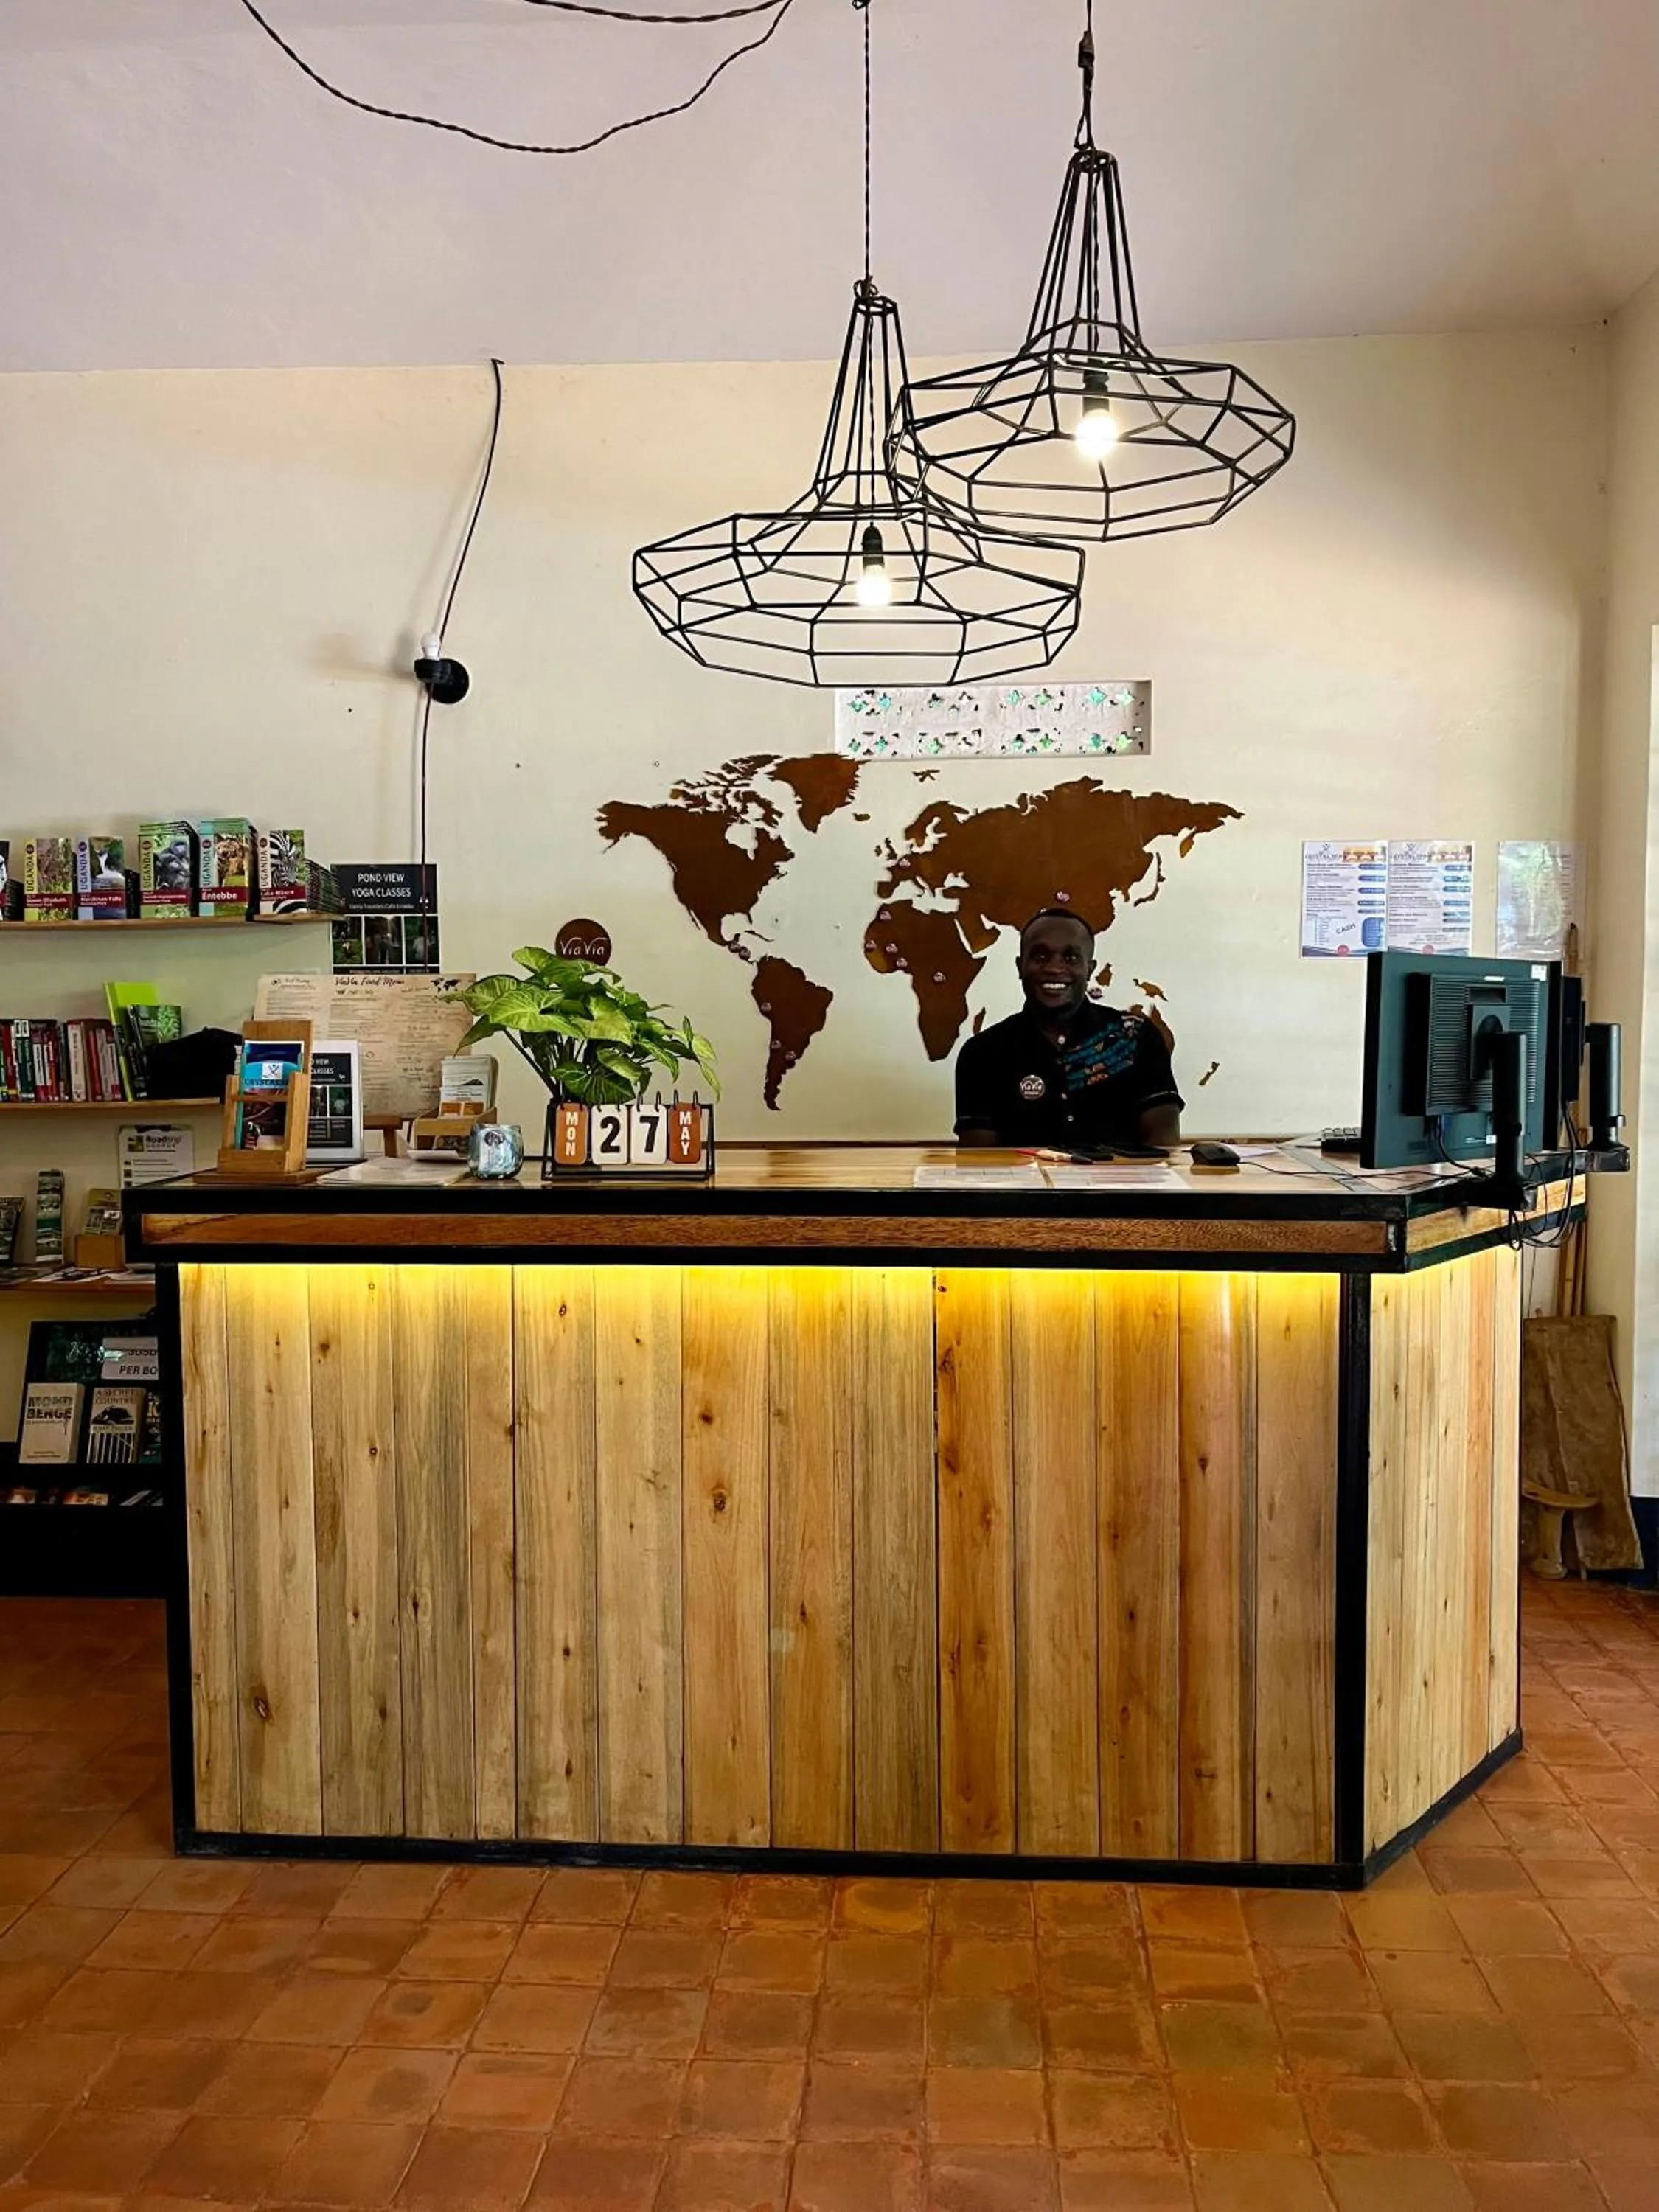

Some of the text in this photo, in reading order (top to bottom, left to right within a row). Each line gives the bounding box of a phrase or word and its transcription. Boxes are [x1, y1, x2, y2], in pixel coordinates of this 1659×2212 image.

[26, 856, 35, 892] UGANDA
[80, 853, 88, 891] UGANDA
[142, 852, 151, 890] UGANDA
[202, 849, 212, 888] UGANDA
[260, 850, 269, 888] UGANDA
[358, 873, 405, 883] POND VIEW
[201, 891, 237, 900] Entebbe
[352, 887, 412, 897] YOGA CLASSES
[566, 1111, 579, 1156] MON
[679, 1111, 692, 1155] MAY
[119, 1365, 141, 1375] PER
